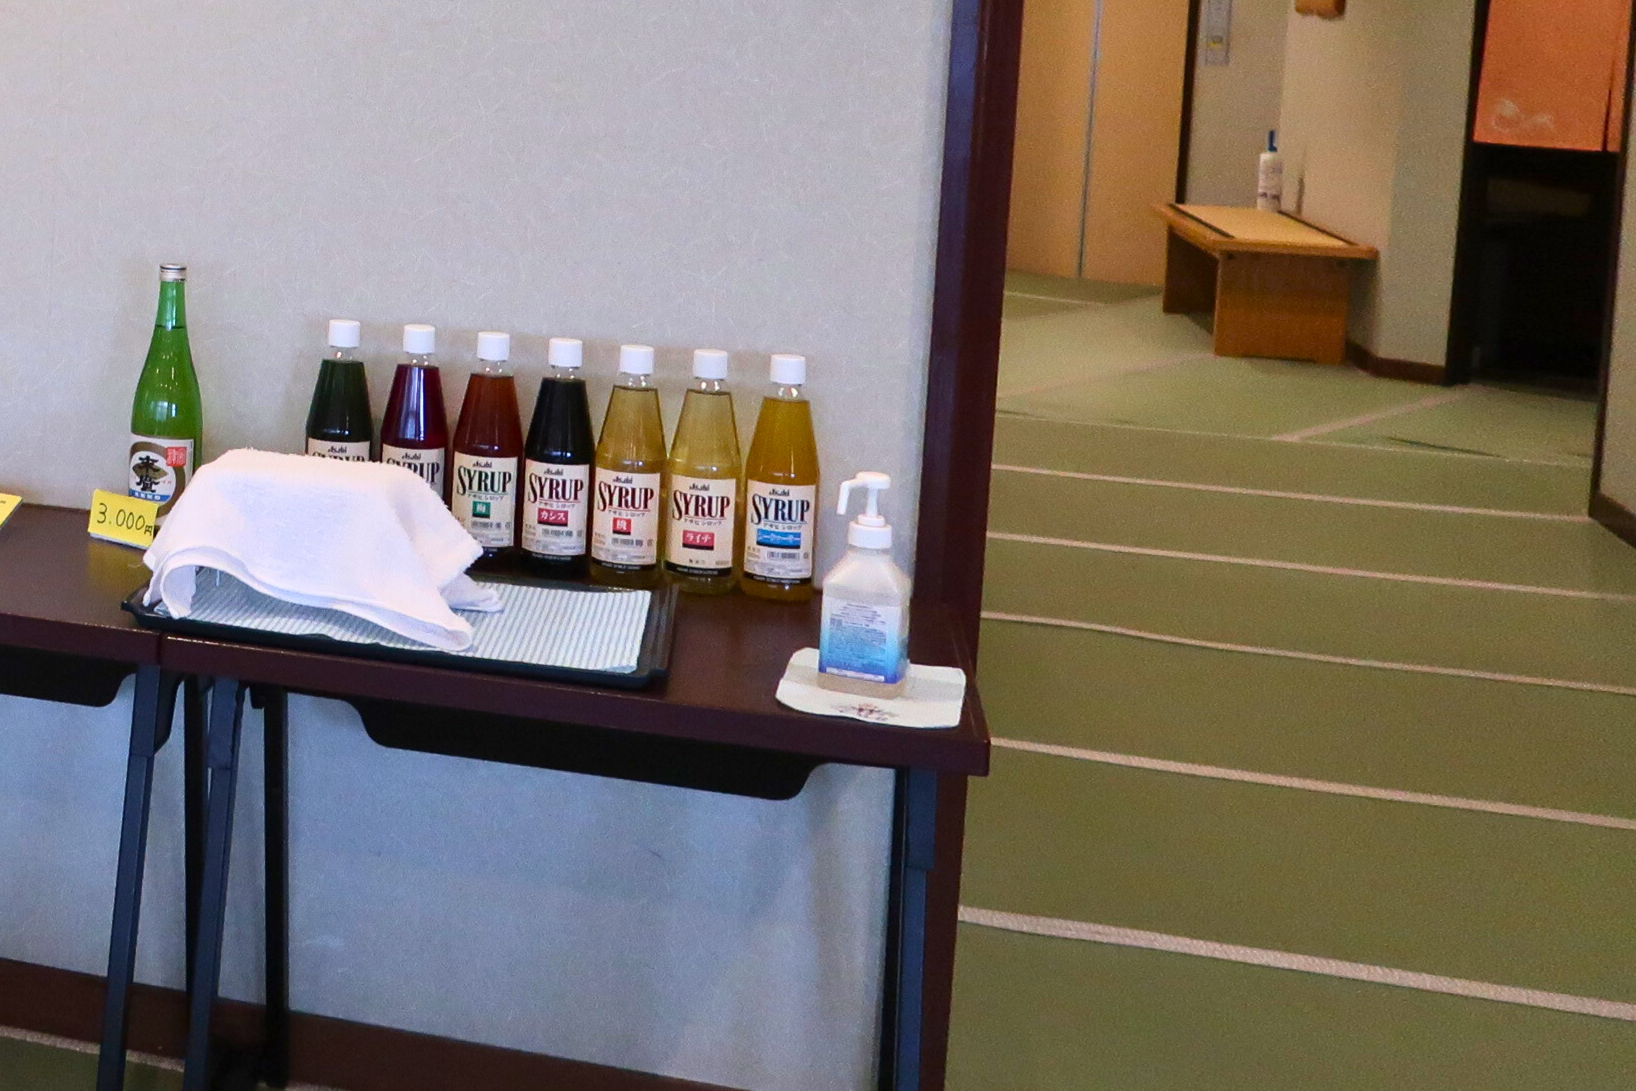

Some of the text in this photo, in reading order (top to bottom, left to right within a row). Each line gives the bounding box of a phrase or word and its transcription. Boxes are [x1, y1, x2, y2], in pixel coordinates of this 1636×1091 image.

[457, 465, 512, 496] SYRUP
[528, 472, 584, 504] SYRUP
[598, 481, 654, 512] SYRUP
[673, 490, 731, 521] SYRUP
[750, 494, 810, 526] SYRUP
